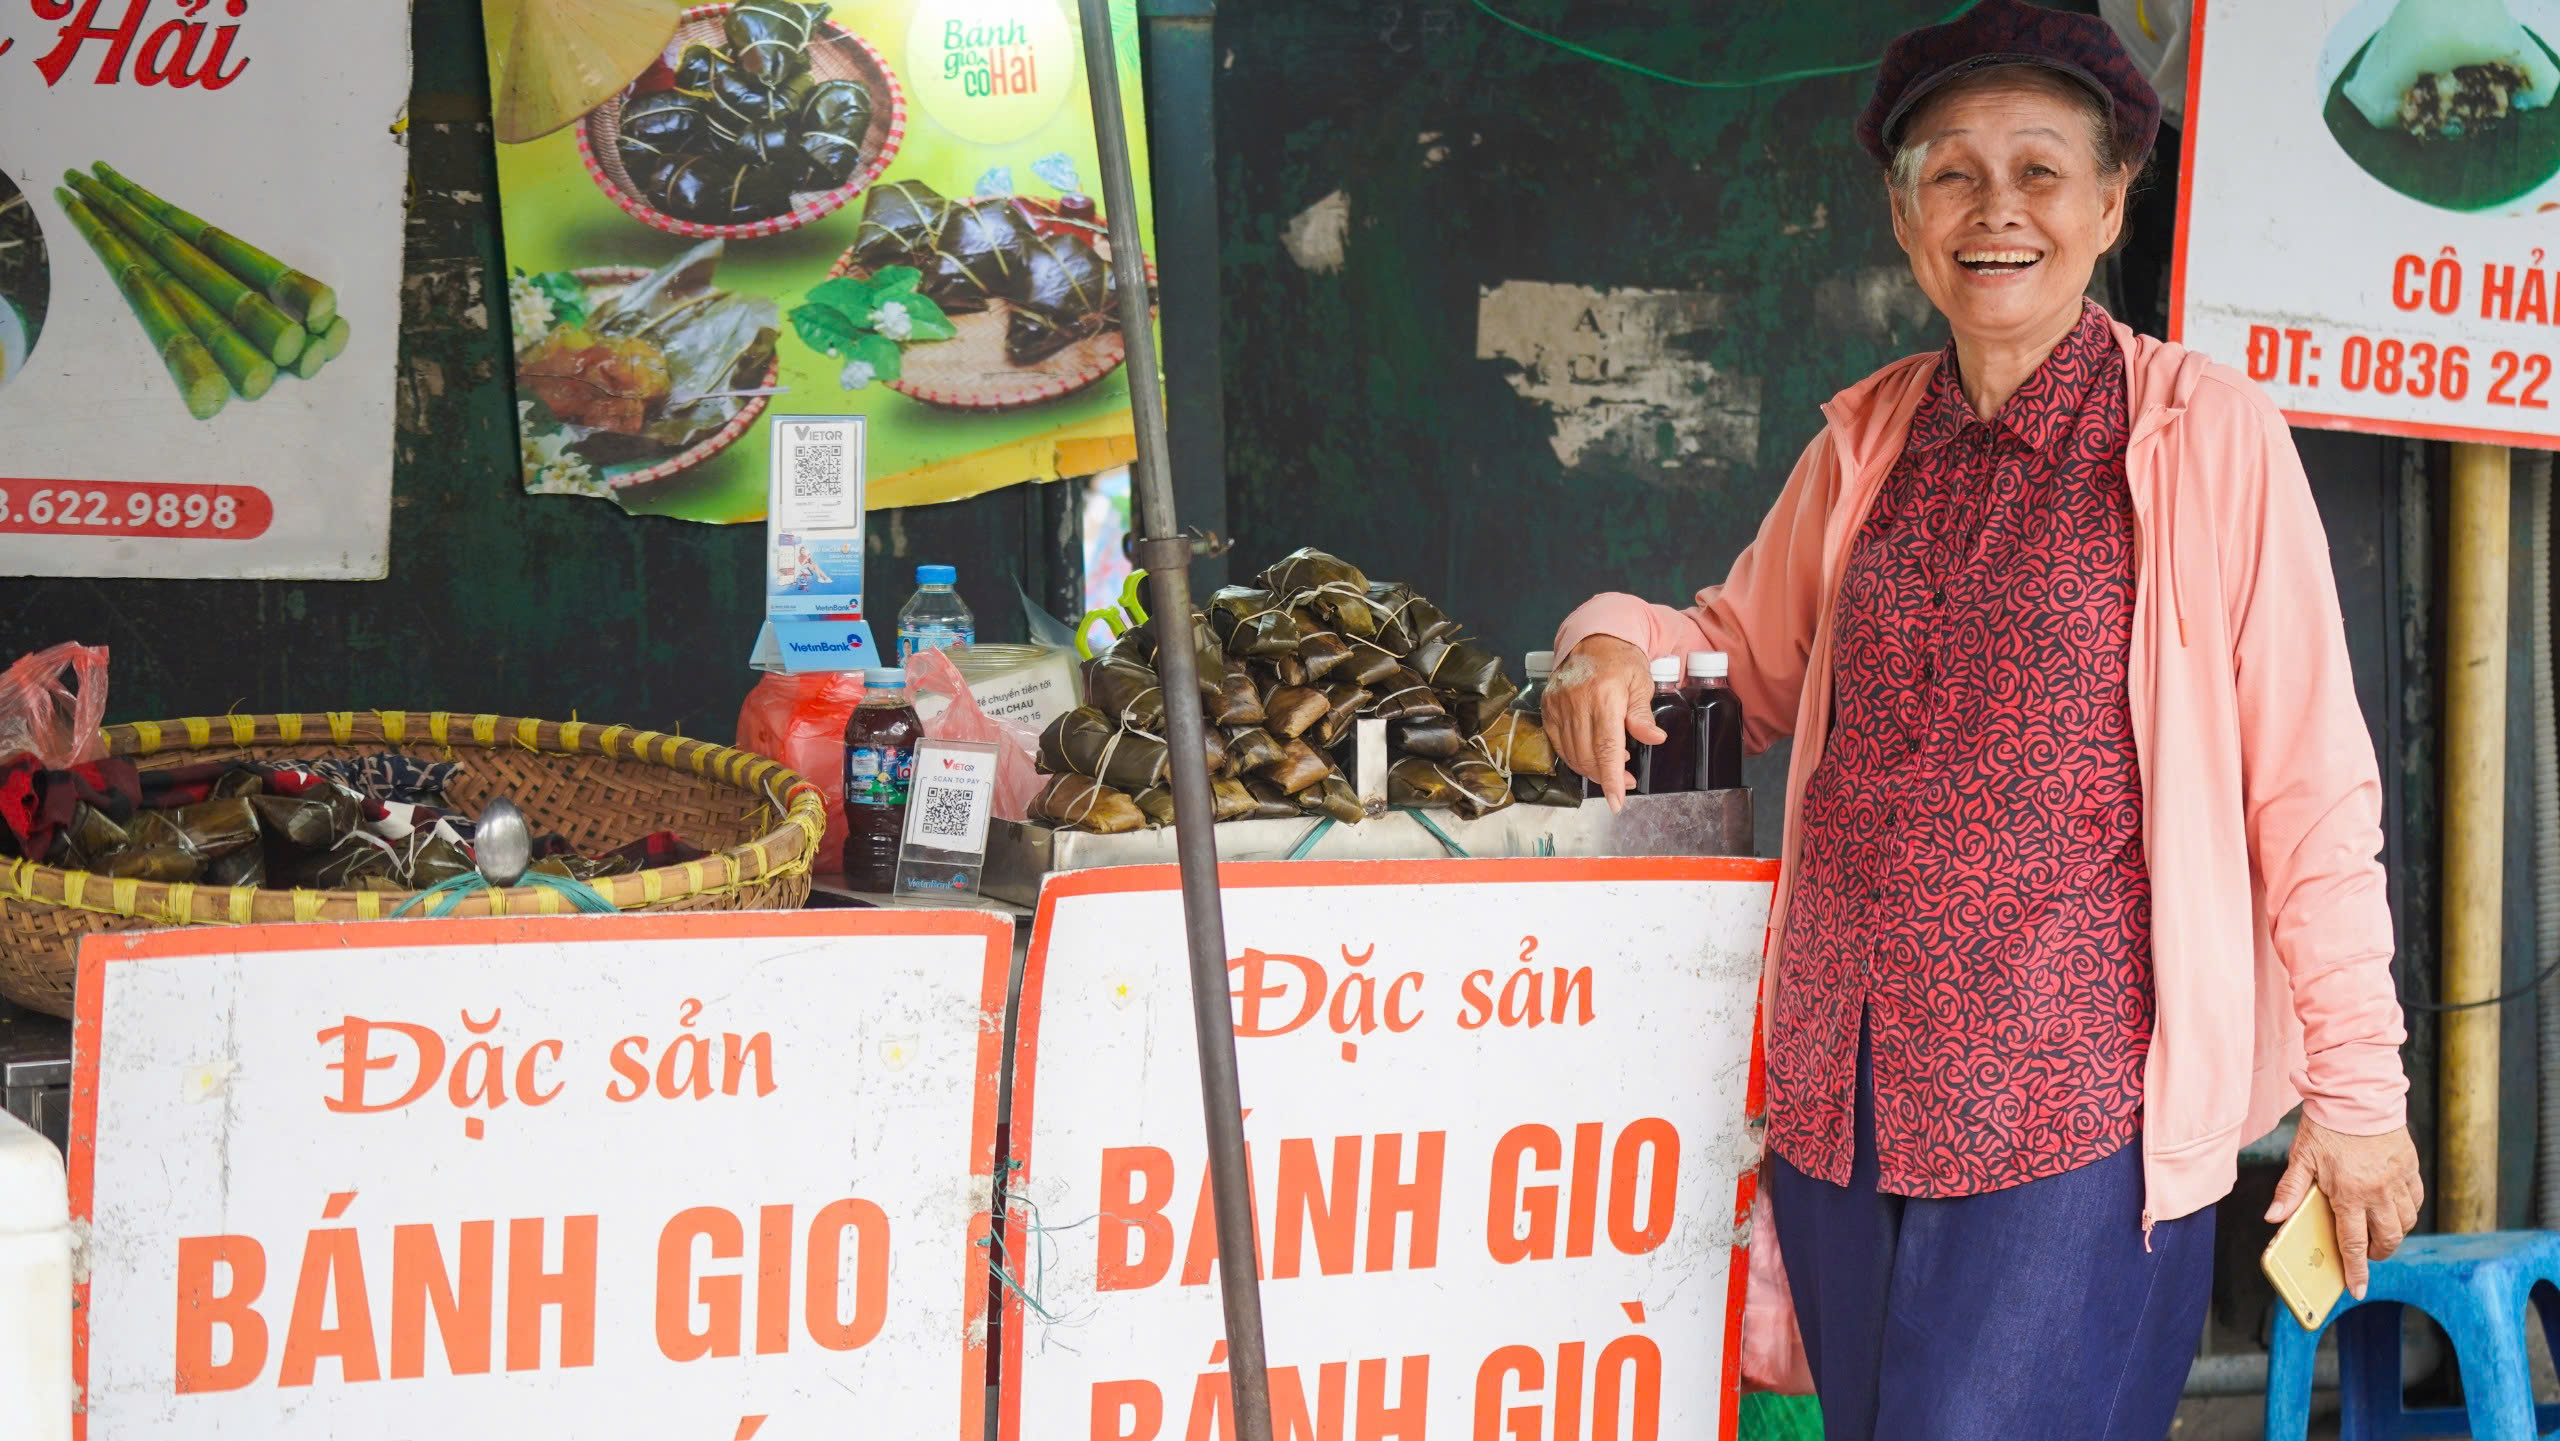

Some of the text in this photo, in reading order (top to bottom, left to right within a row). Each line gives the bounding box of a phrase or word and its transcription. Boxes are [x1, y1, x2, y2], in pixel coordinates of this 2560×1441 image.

[30, 0, 250, 90] Hải
[2392, 246, 2463, 316] CÔ
[2246, 324, 2553, 410] ĐT: 0836 22
[789, 642, 851, 653] VietinBank
[1006, 699, 1035, 713] CHAU
[932, 775, 953, 784] SCAN
[1226, 935, 1597, 1063] Đặc sản
[315, 997, 779, 1142] Đặc sản
[1486, 1117, 1681, 1265] GIO
[174, 1191, 892, 1396] BÁNH GIO
[1472, 1301, 1663, 1441] GIÒ
